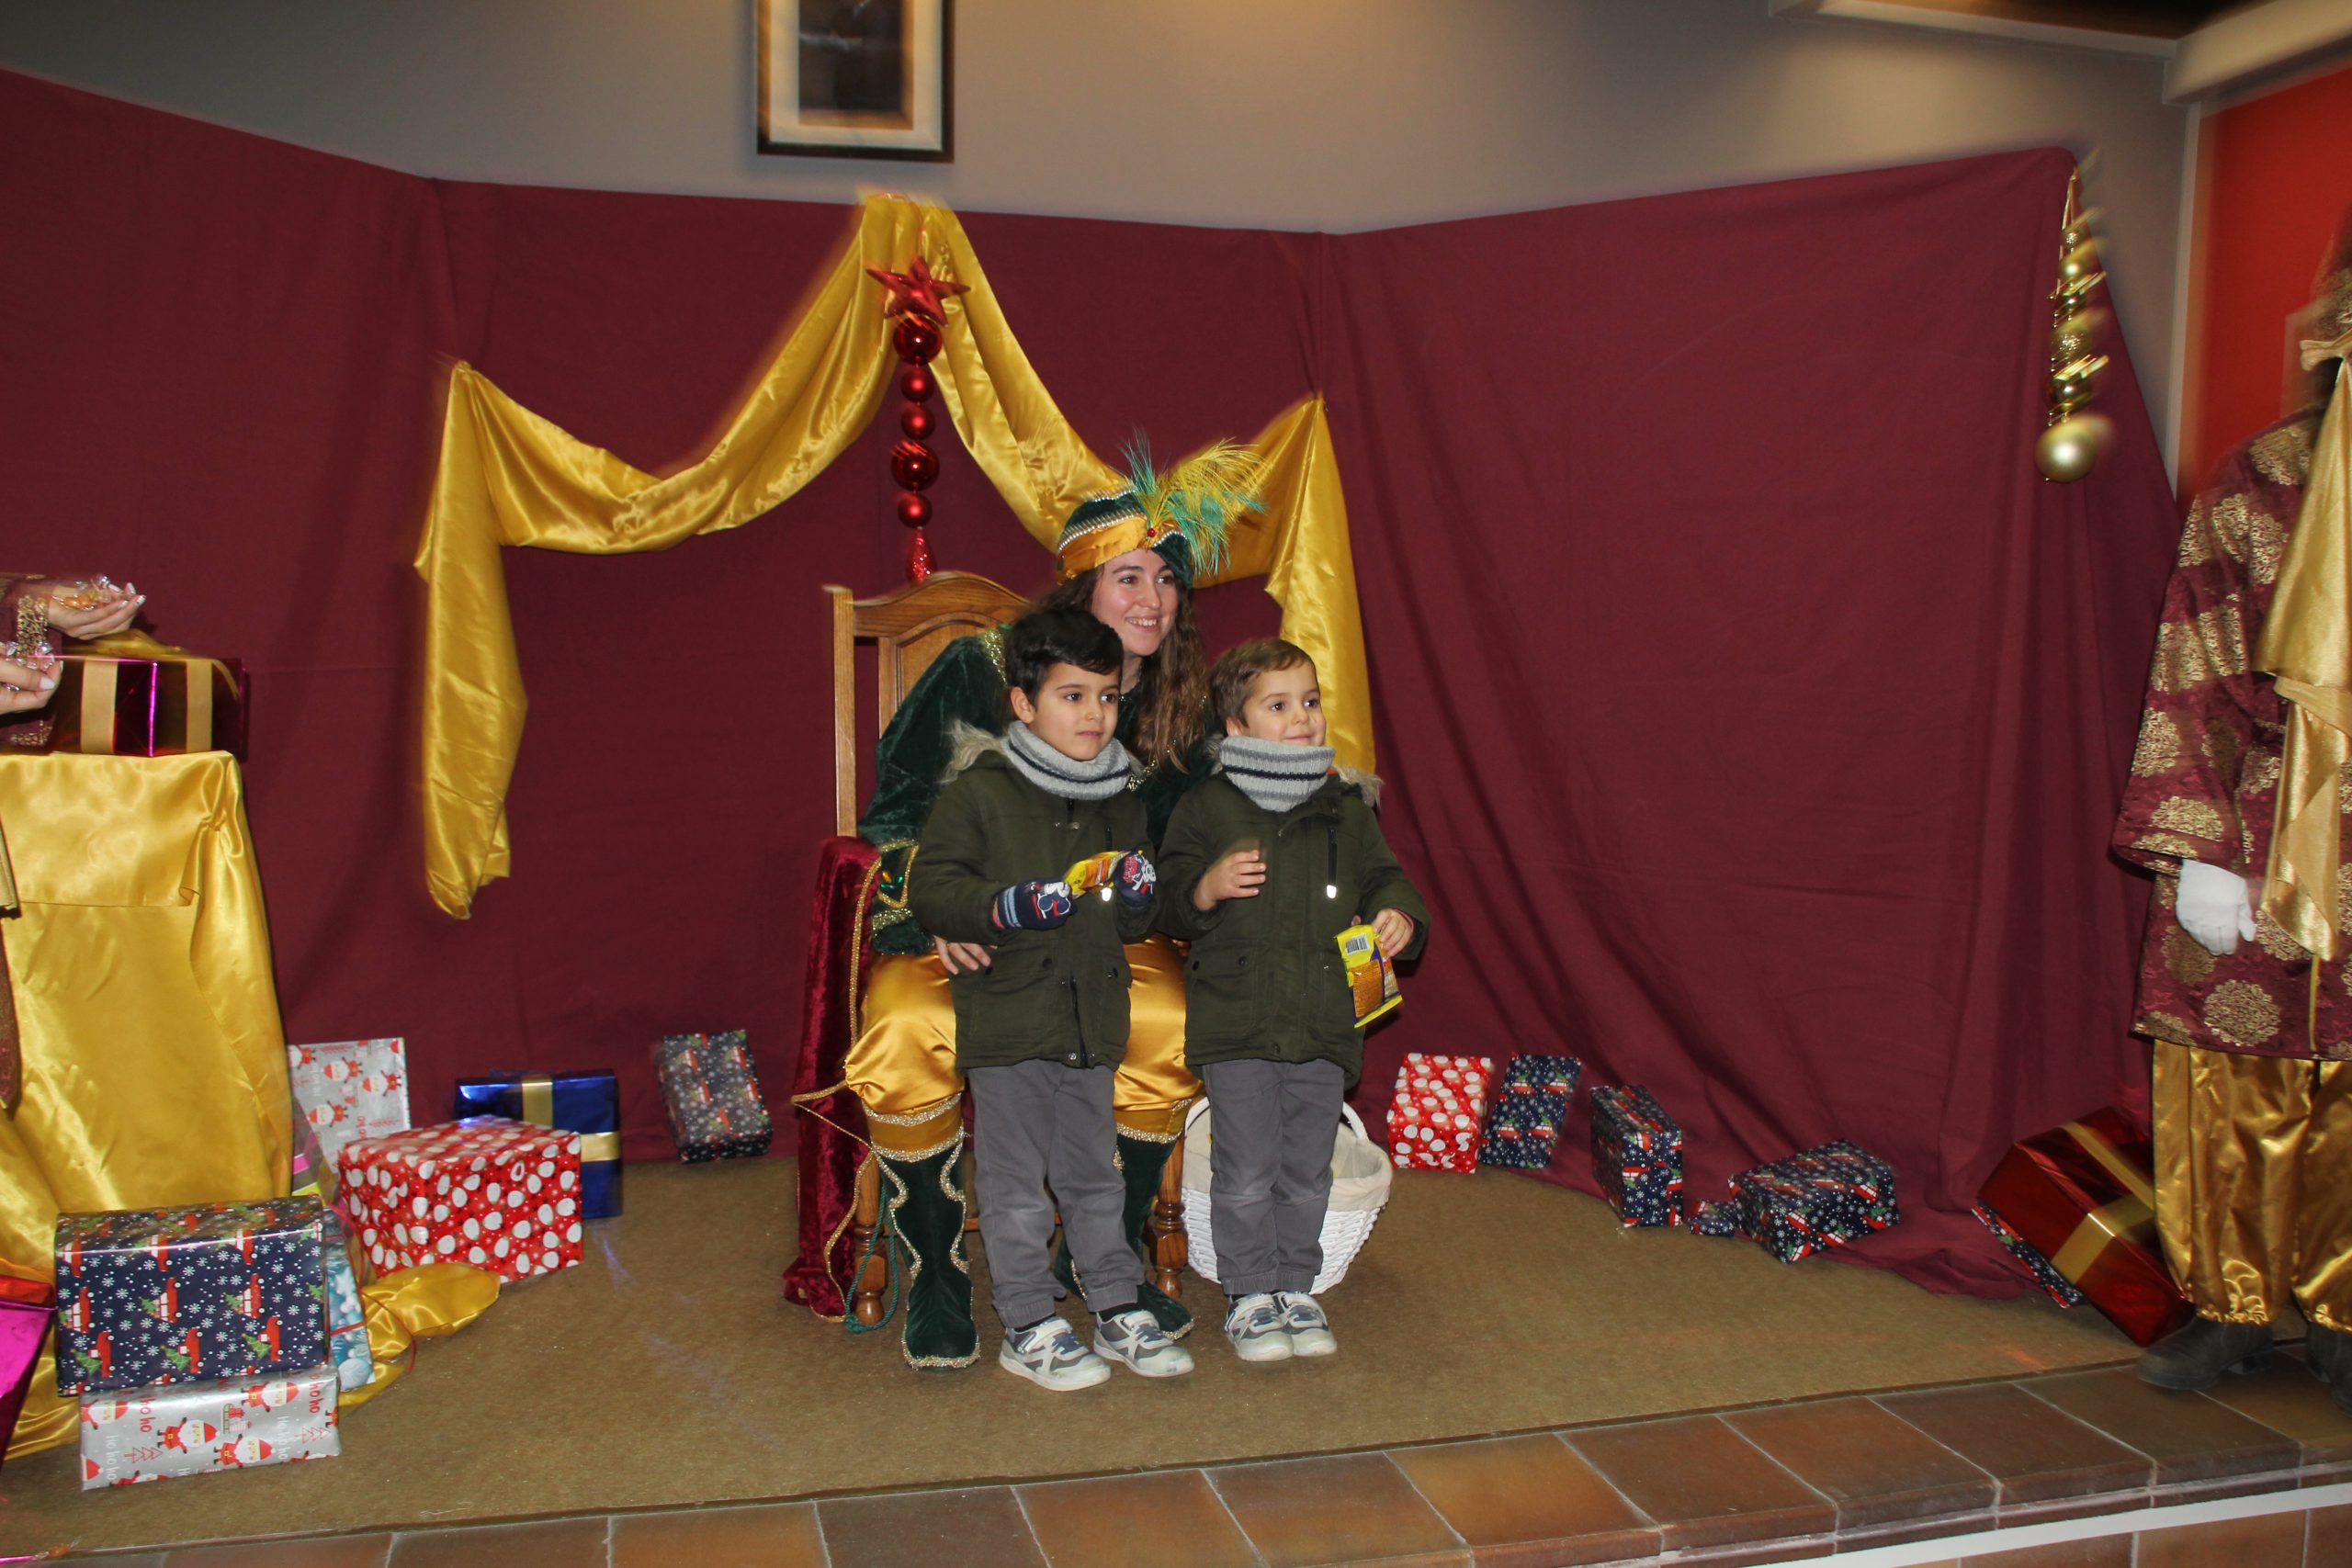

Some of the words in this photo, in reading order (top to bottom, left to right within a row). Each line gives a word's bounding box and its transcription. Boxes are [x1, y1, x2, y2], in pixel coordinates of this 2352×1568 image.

[309, 1382, 324, 1398] ho
[140, 1397, 157, 1416] ho
[309, 1398, 324, 1414] ho
[140, 1416, 157, 1433] ho
[277, 1416, 290, 1429] Ho
[106, 1435, 118, 1450] Ho
[277, 1431, 291, 1446] ho
[106, 1450, 120, 1465] ho
[277, 1447, 291, 1460] ho
[106, 1466, 120, 1481] ho
